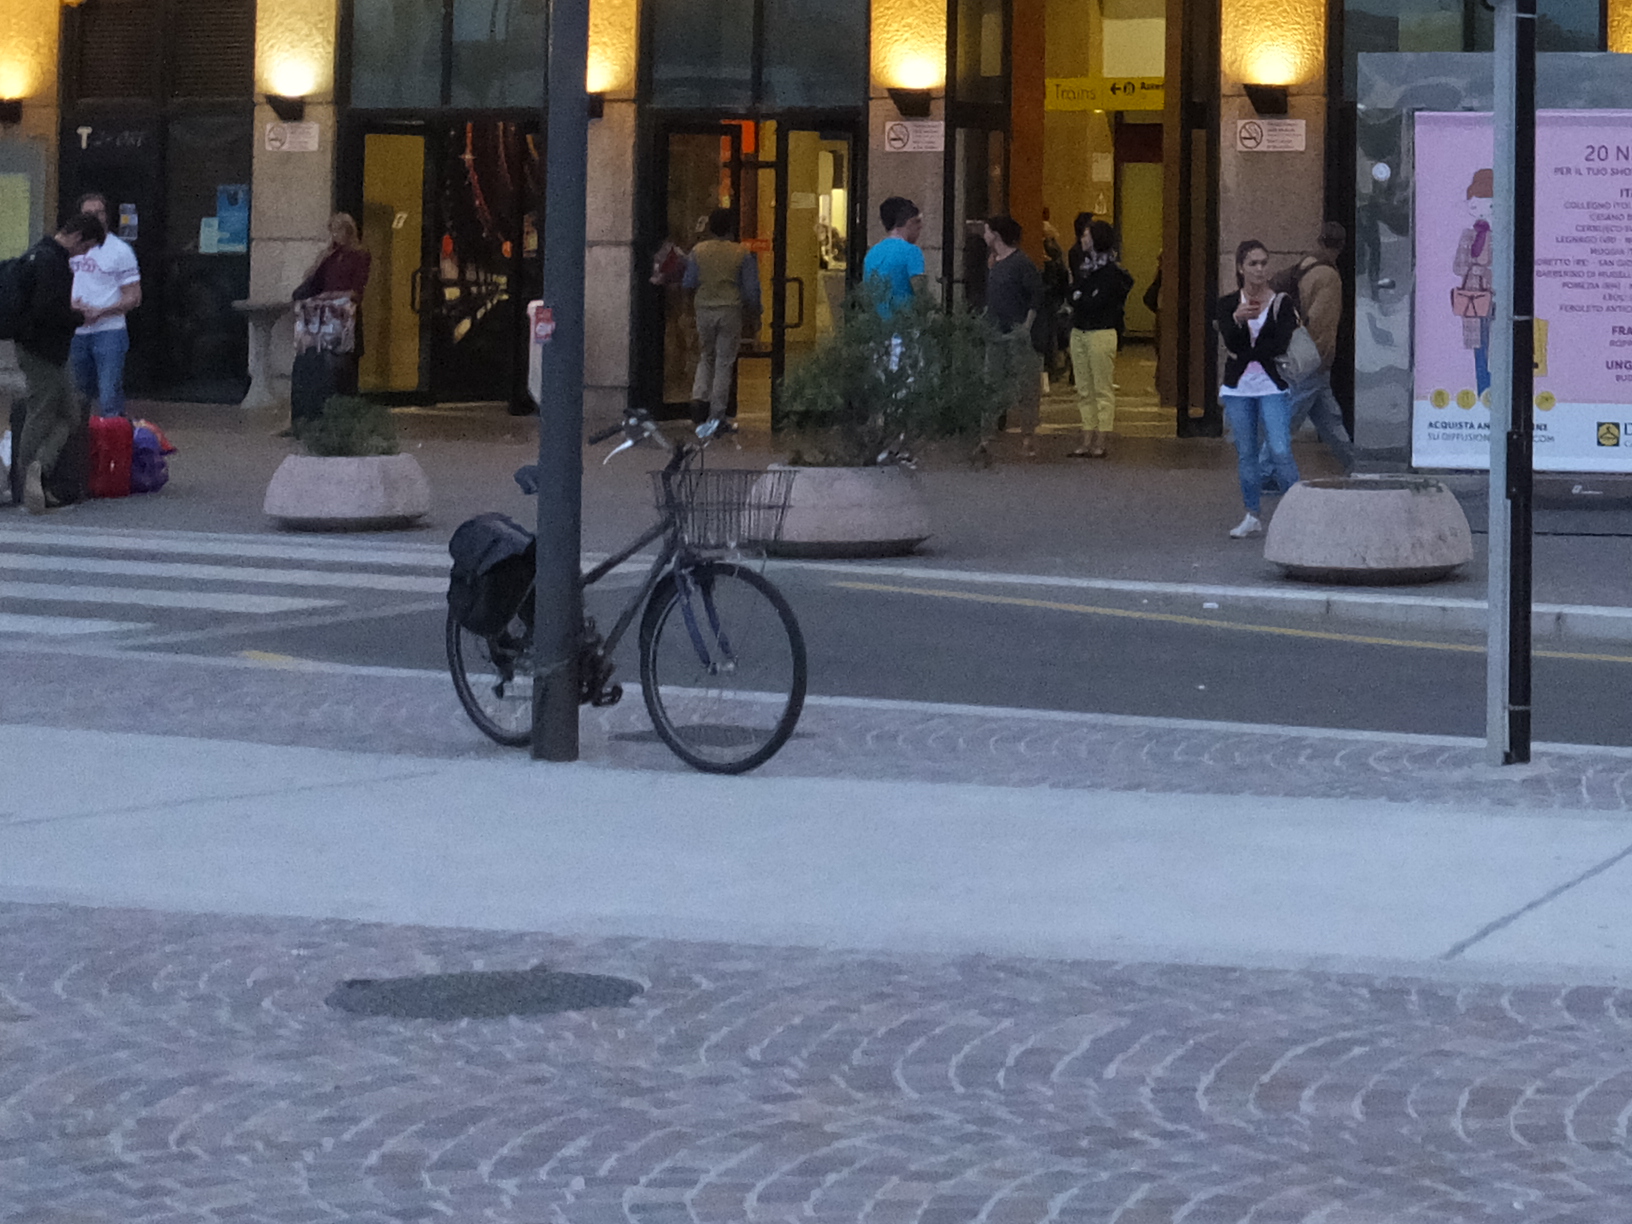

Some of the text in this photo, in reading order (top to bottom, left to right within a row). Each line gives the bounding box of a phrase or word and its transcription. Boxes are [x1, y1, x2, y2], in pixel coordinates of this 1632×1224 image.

[1055, 83, 1096, 101] Trains
[1584, 145, 1609, 162] 20
[1554, 167, 1572, 176] PER
[1586, 167, 1608, 176] TUO
[1427, 421, 1474, 431] ACQUISTA
